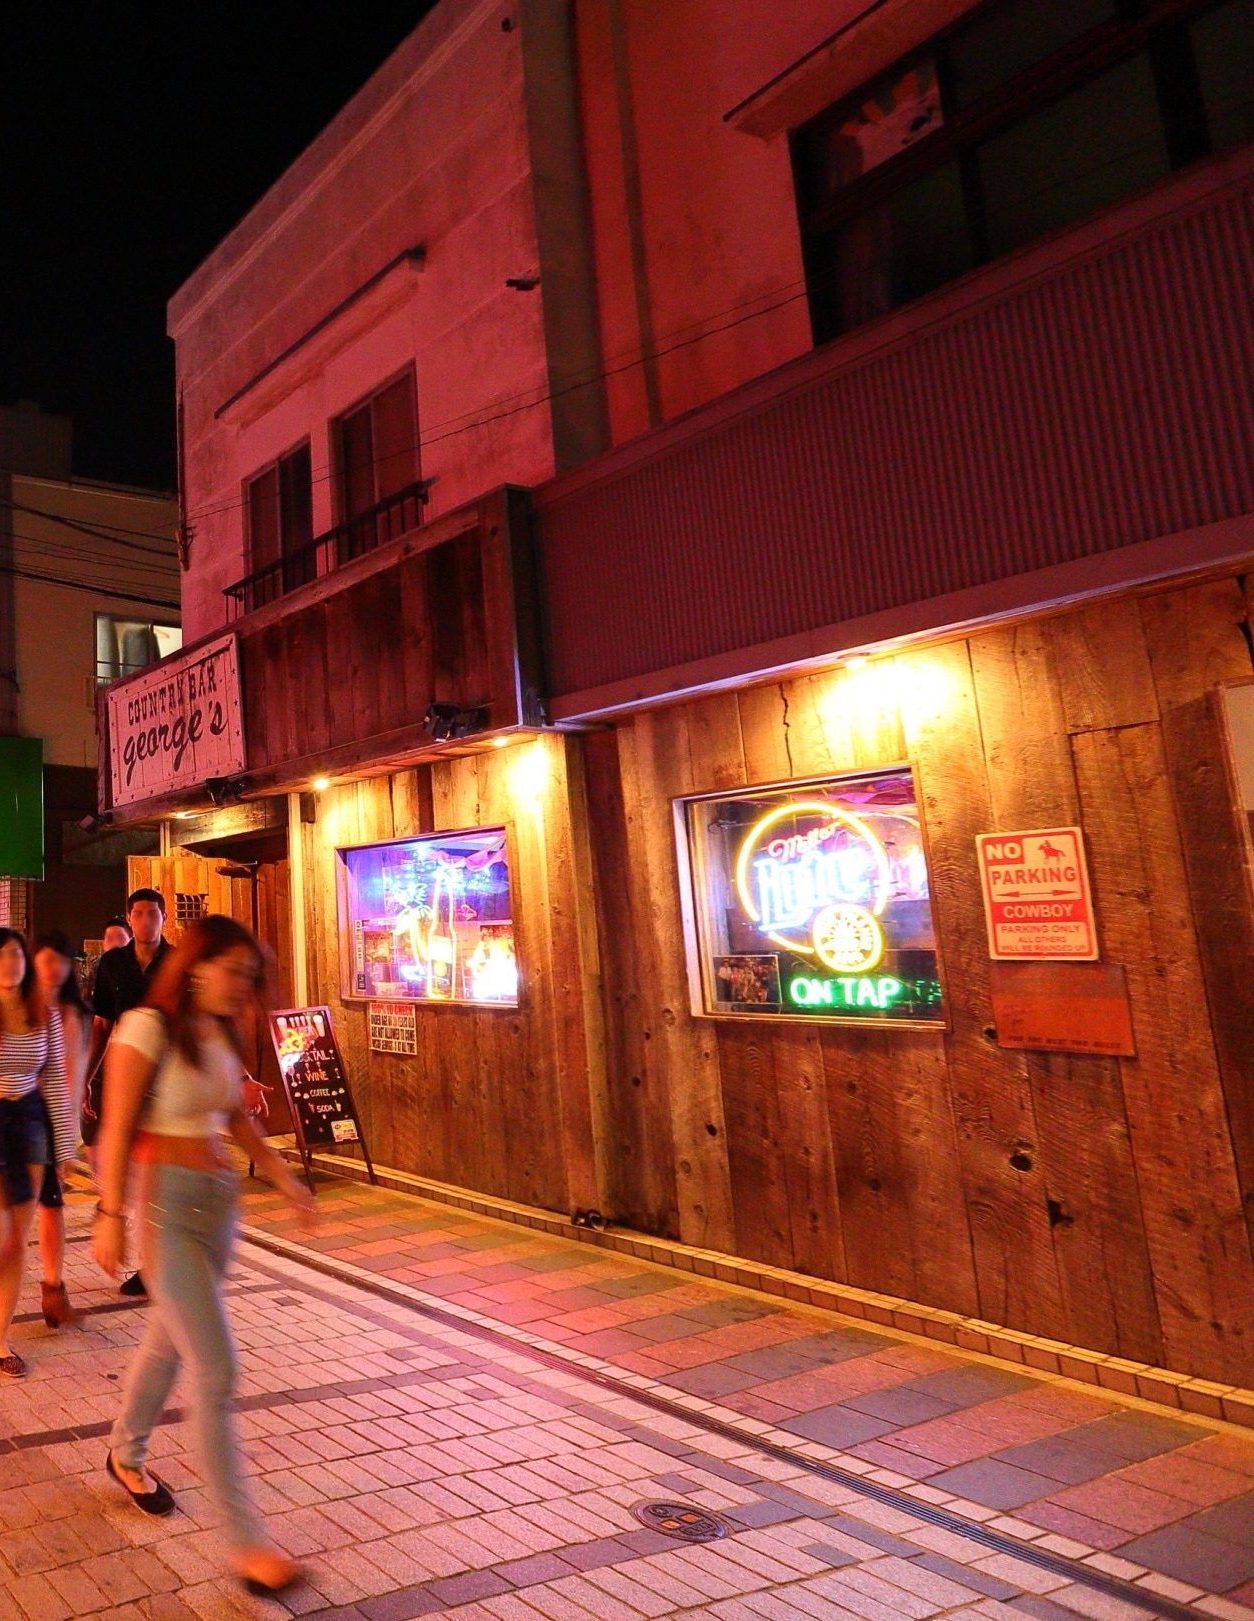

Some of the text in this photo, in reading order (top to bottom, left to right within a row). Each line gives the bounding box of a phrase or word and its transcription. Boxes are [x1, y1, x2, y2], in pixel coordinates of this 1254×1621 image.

[128, 665, 217, 726] COUNTRY BAR
[986, 842, 1021, 860] NO
[991, 866, 1077, 885] PARKING
[1003, 903, 1073, 919] COWBOY
[1001, 924, 1081, 934] PARKING ONLY
[790, 977, 901, 1008] ON TAP
[305, 1071, 329, 1082] WINE
[316, 1104, 335, 1113] SODA
